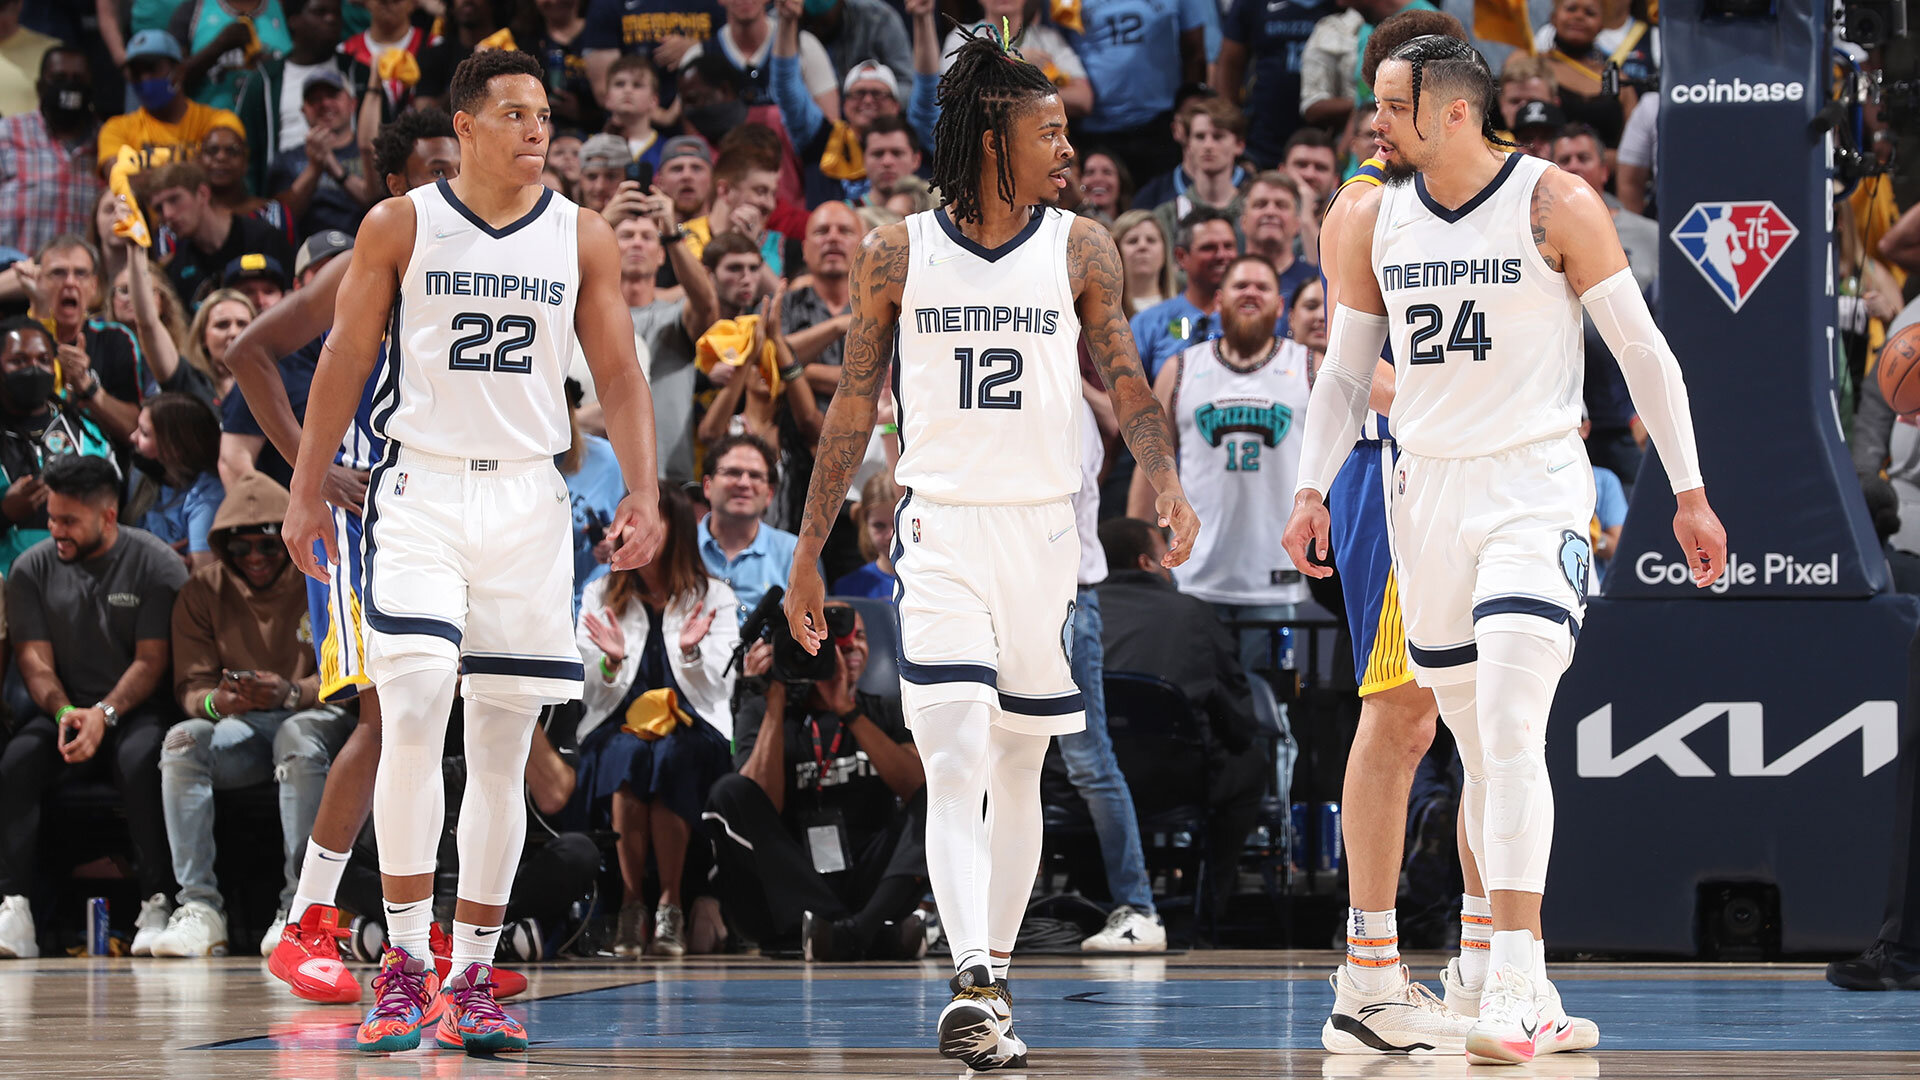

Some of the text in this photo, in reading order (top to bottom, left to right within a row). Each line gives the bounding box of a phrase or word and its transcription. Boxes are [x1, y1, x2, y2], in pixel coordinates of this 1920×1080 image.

[1105, 13, 1144, 46] 12
[1671, 77, 1804, 104] coinbase
[1744, 216, 1769, 250] 75
[425, 270, 566, 306] MEMPHIS
[1383, 258, 1522, 292] MEMPHIS
[915, 305, 1060, 335] MEMPHIS
[1405, 299, 1493, 365] 24
[448, 312, 536, 374] 22
[954, 347, 1023, 410] 12
[1194, 402, 1292, 448] GRIZZLIES
[1225, 440, 1260, 472] 12
[1764, 552, 1839, 585] Pixel
